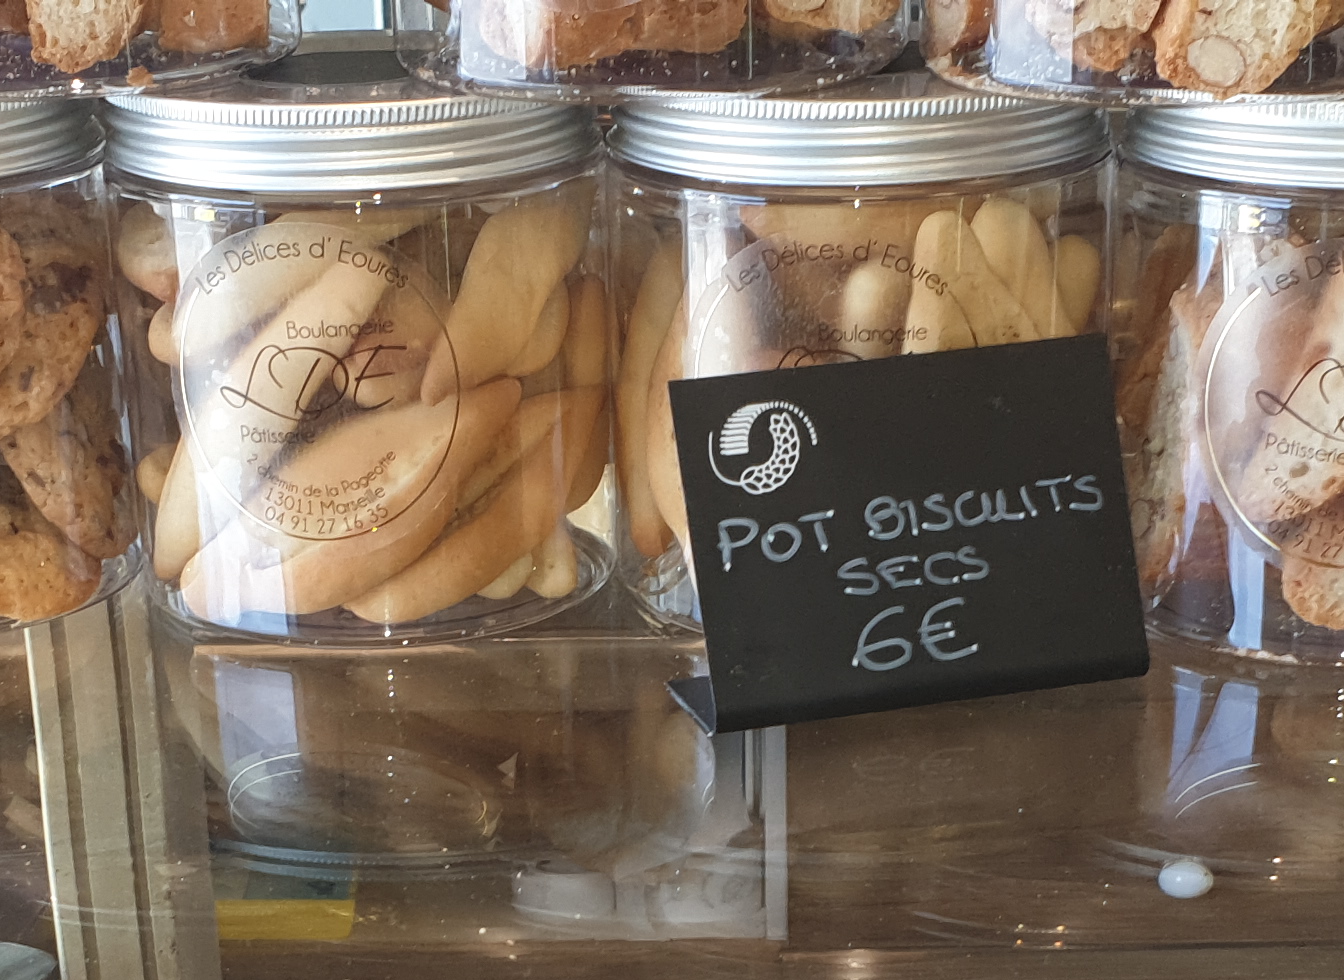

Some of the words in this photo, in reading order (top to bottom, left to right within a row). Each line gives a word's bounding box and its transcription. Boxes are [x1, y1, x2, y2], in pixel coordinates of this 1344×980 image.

[195, 264, 226, 296] Les
[223, 241, 301, 273] Délices
[338, 239, 410, 289] Eoures
[726, 263, 761, 293] Les
[761, 240, 843, 272] Délices
[881, 243, 950, 297] Eoures
[1260, 266, 1300, 297] Les
[285, 320, 394, 340] Boulangerie
[817, 323, 928, 346] Boulangerie
[240, 425, 316, 444] Pâtisserie
[258, 464, 299, 495] chemin
[304, 484, 322, 498] de
[326, 484, 340, 496] la
[340, 449, 398, 494] Pageotte
[265, 487, 314, 516] 13011
[320, 486, 386, 516] Marseille
[265, 507, 285, 526] 04
[290, 516, 309, 533] 91
[317, 520, 336, 535] 27
[345, 516, 364, 532] 16
[367, 504, 389, 524] 35
[717, 508, 835, 573] POT
[863, 473, 1104, 541] BISCUITS
[1320, 542, 1343, 559] 27
[837, 544, 990, 596] SECS
[851, 596, 979, 672] 6€
